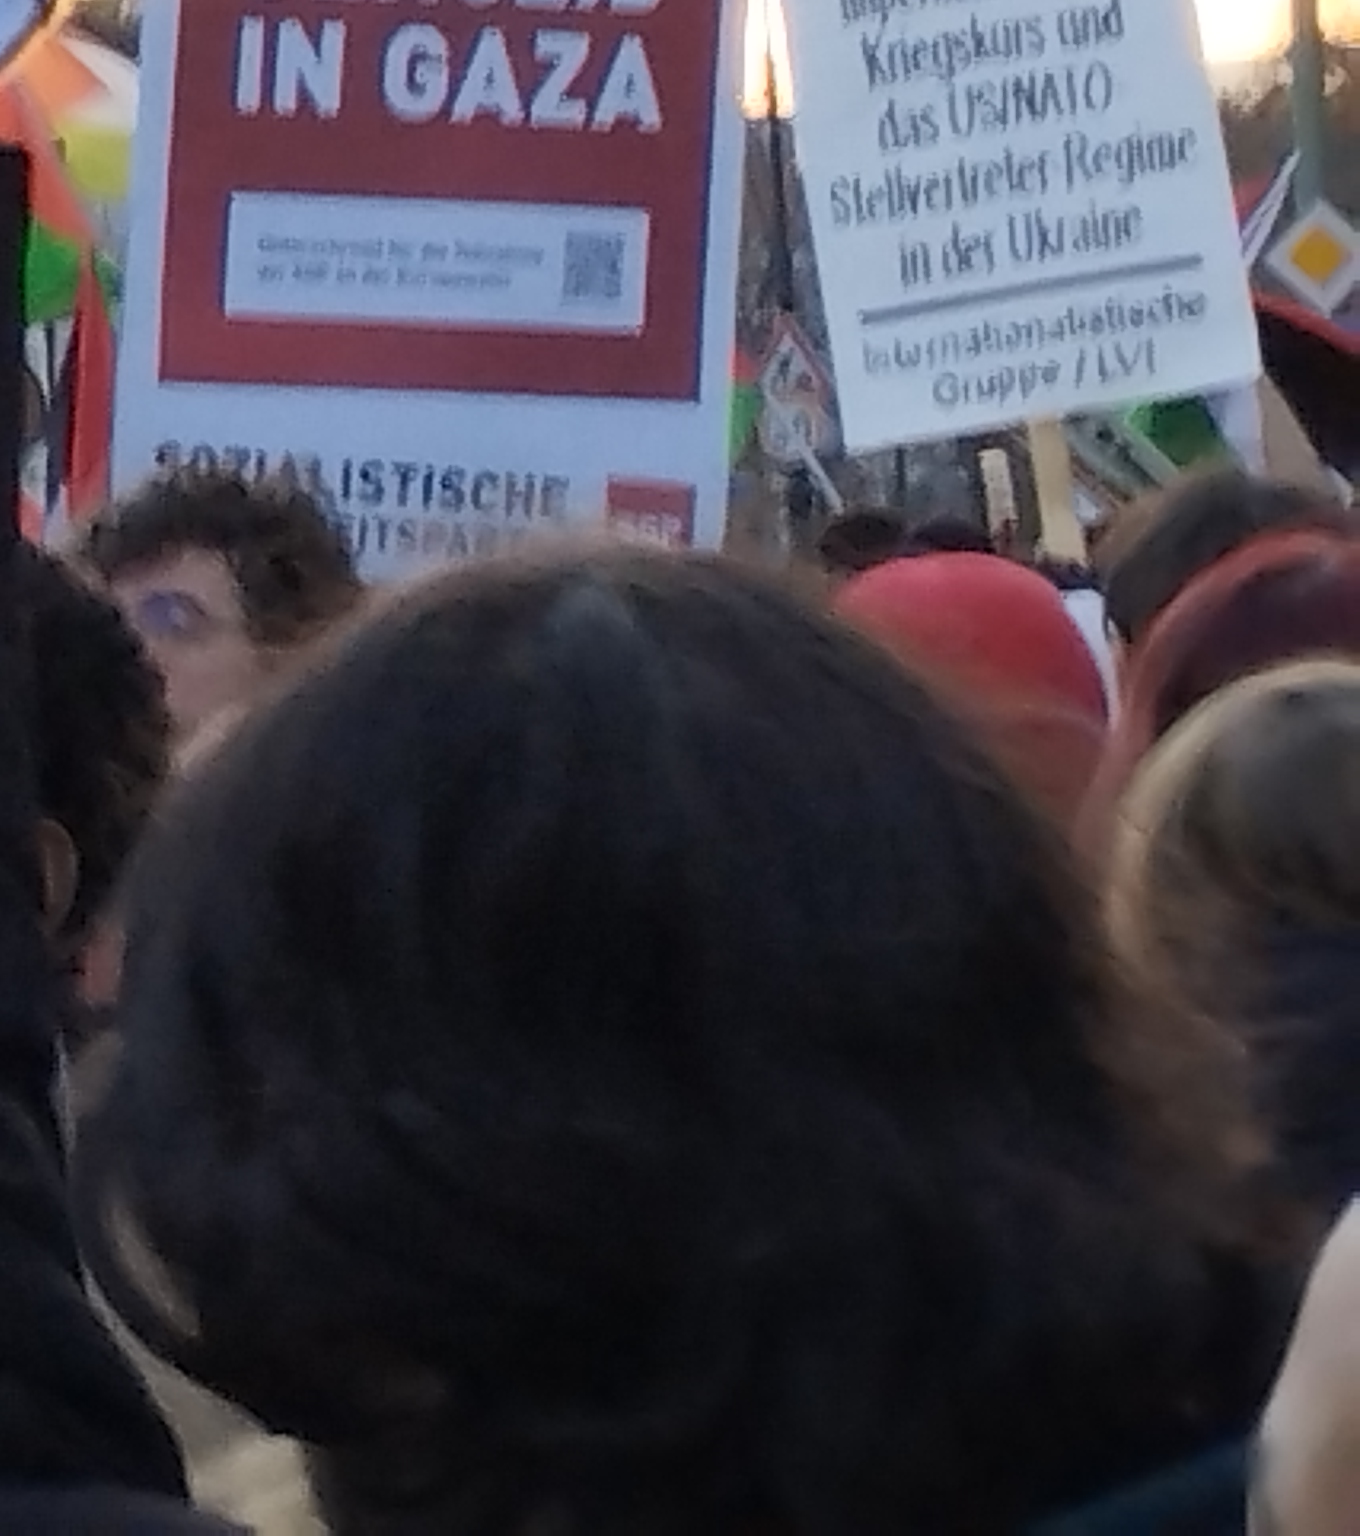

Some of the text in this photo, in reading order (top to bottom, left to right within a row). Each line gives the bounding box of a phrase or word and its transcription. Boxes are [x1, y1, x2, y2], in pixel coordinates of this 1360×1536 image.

[235, 14, 664, 134] IN GAZA
[860, 12, 1046, 93] Kriegskurs
[1063, 120, 1198, 195] Regime
[900, 198, 1143, 291] in der Ukraine
